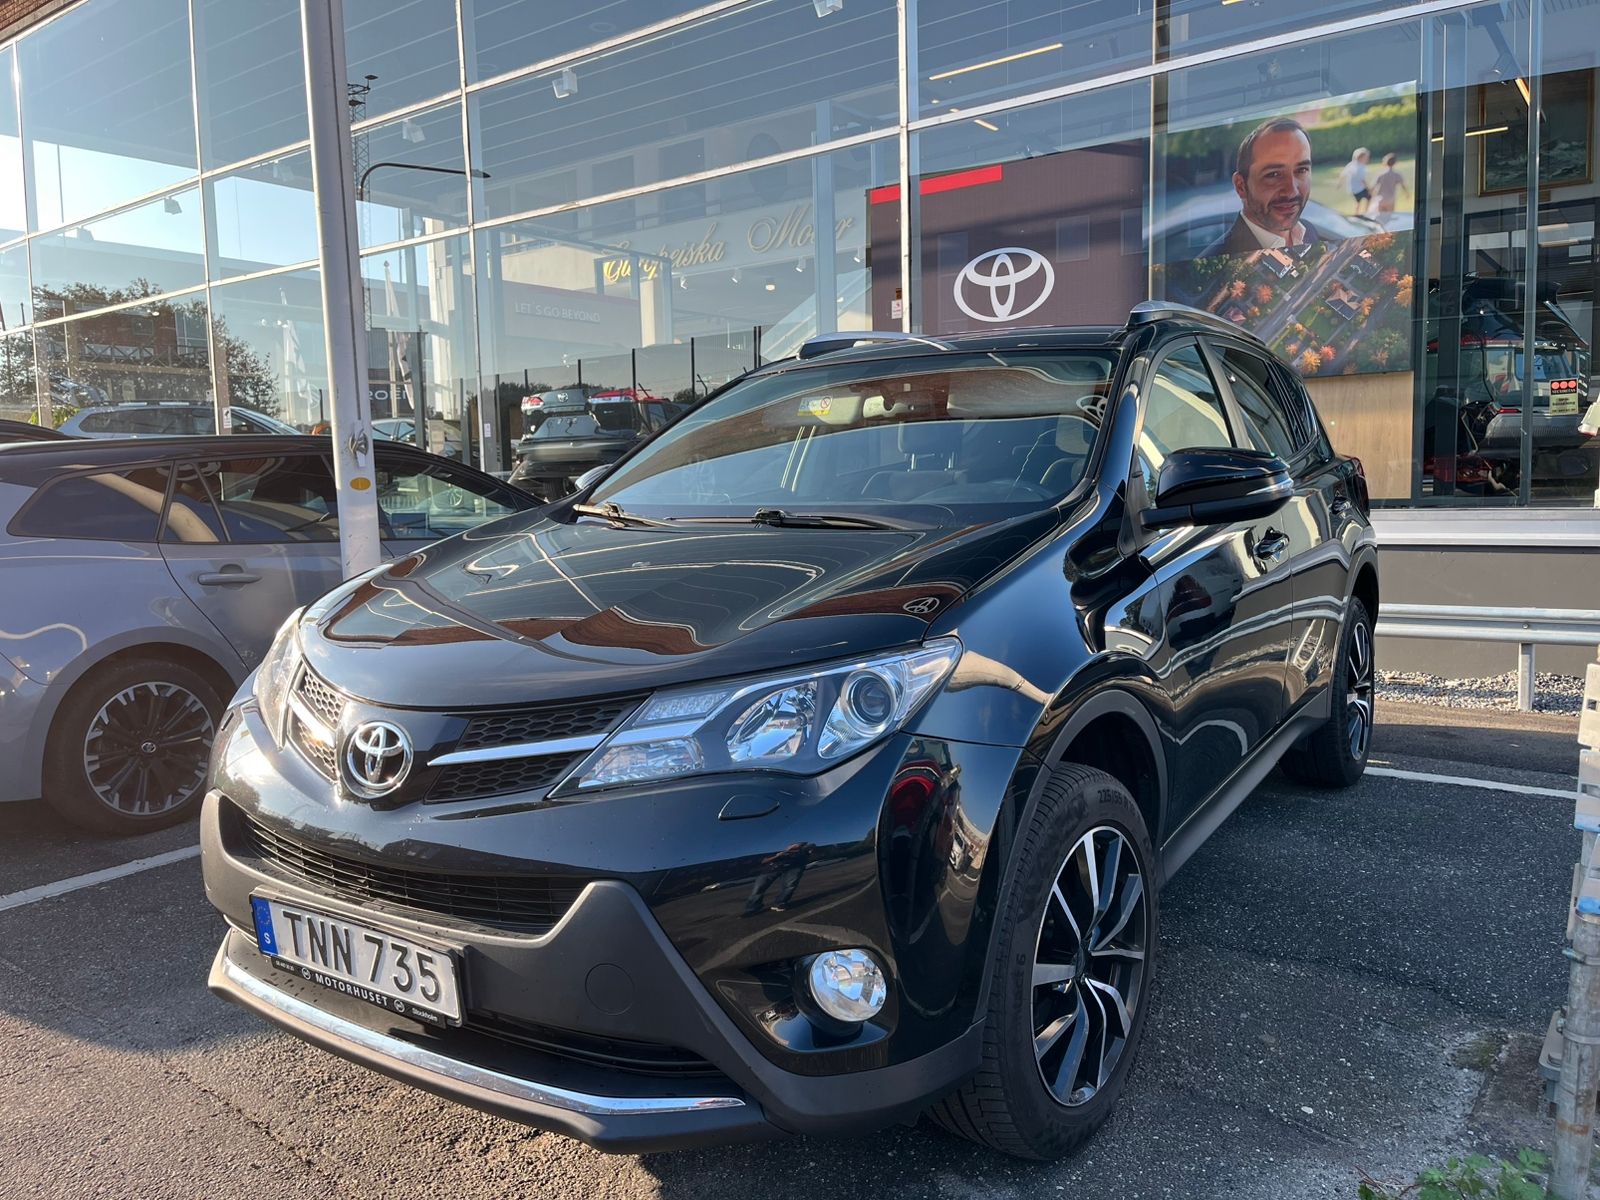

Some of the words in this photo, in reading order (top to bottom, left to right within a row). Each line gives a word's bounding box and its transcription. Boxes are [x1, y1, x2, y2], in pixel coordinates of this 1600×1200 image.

[748, 203, 853, 253] Mor
[543, 306, 560, 318] GO
[562, 308, 600, 323] BEYOND
[264, 932, 271, 945] S
[282, 910, 353, 976] TNN
[363, 933, 440, 1003] 735
[1015, 953, 1026, 966] 6
[314, 972, 389, 1007] MOTORHUSET
[411, 1007, 439, 1023] Stockholm
